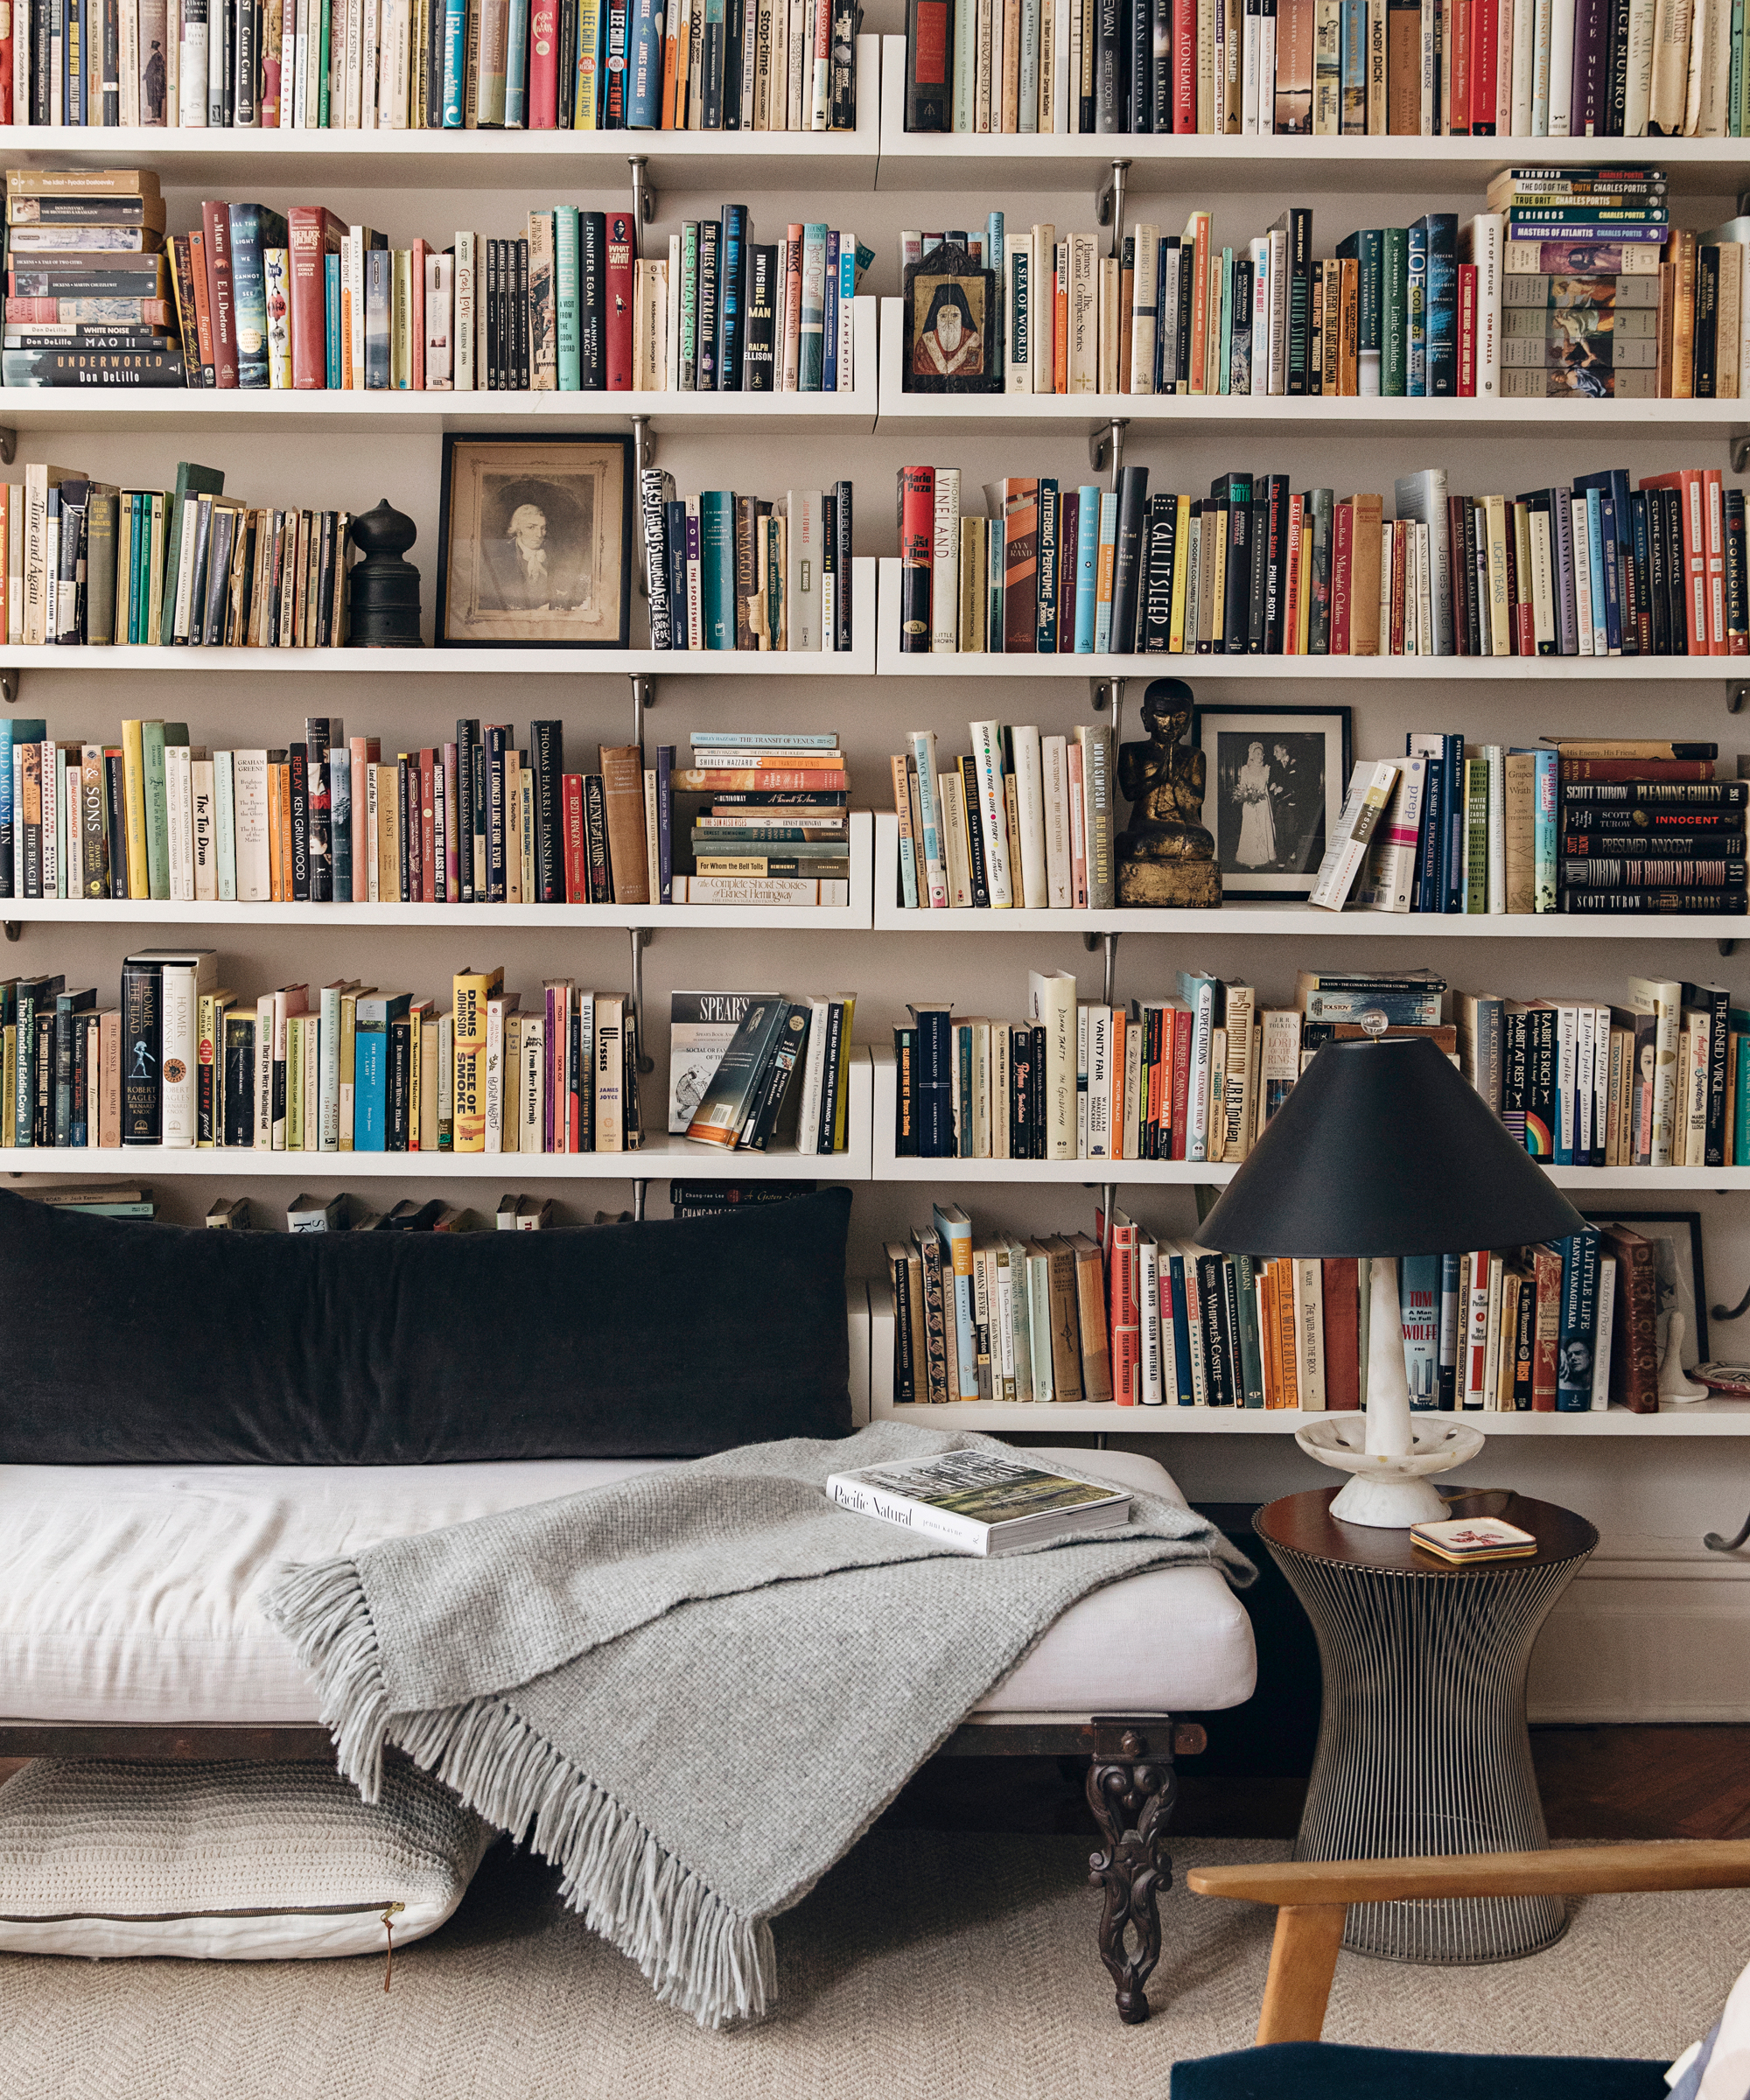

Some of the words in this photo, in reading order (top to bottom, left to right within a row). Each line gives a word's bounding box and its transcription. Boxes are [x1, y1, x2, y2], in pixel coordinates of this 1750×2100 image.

[583, 10, 595, 25] LEE
[611, 10, 625, 25] LEE
[242, 27, 250, 56] CALEB
[582, 29, 594, 53] CHILD
[610, 28, 623, 53] CHILD
[760, 10, 771, 75] Stop-time
[1373, 21, 1382, 52] MOBY
[1180, 32, 1190, 109] ATONEMENT
[611, 87, 622, 117] ENEMY
[214, 224, 223, 252] MARCH
[686, 227, 695, 268] LESS
[1074, 239, 1083, 280] O'Connor
[1082, 243, 1093, 279] Flannery
[1408, 241, 1425, 287] JOE
[1488, 250, 1494, 260] OF
[218, 281, 228, 290] E.
[685, 271, 694, 312] THAN
[756, 255, 766, 304] INVISIBLE
[1018, 267, 1026, 290] SEA
[749, 307, 771, 318] MAN
[1018, 293, 1026, 310] OF
[1075, 284, 1085, 323] Complete
[201, 316, 210, 351] Ragtime
[219, 303, 228, 344] Doctorow
[1390, 306, 1399, 331] Little
[683, 317, 693, 360] ZERO
[1018, 313, 1026, 361] WORDS
[1076, 325, 1085, 352] Stories
[1390, 333, 1399, 372] Children
[58, 356, 162, 368] UNDERWORLD
[744, 352, 772, 361] ELLISON
[80, 372, 97, 382] Don
[103, 372, 139, 382] DeLillo
[1271, 483, 1280, 499] The
[31, 501, 44, 533] Time
[934, 478, 949, 558] VINELAND
[1043, 488, 1055, 546] JITTERBUG
[31, 536, 43, 560] and
[1152, 522, 1172, 556] CALL
[1151, 562, 1171, 578] IT
[1494, 542, 1503, 570] LIGHT
[28, 564, 43, 605] Again
[1042, 550, 1054, 598] PERFUME
[1494, 573, 1504, 603] YEARS
[1148, 579, 1169, 624] SLEEP
[87, 768, 99, 779] &
[88, 788, 100, 831] SONS
[197, 794, 208, 813] The
[542, 775, 551, 816] HARRIS
[1407, 785, 1418, 819] prep
[198, 816, 209, 833] Tin
[199, 837, 209, 865] Drum
[543, 824, 552, 883] HANNIBAL
[130, 982, 139, 1001] THE
[144, 986, 152, 1027] HOMER
[130, 1004, 139, 1033] ILIAD
[458, 990, 466, 1036] JOHNSON
[467, 990, 476, 1036] DENIS
[1716, 1000, 1726, 1019] THE
[1096, 1019, 1104, 1057] VANITY
[1226, 1003, 1250, 1074] SILMARILLION
[1541, 1013, 1551, 1048] RABBIT
[1714, 1021, 1725, 1058] AENEID
[599, 1027, 619, 1071] ULYSSES
[1096, 1060, 1104, 1081] FAIR
[1541, 1061, 1550, 1086] RICH
[1712, 1062, 1724, 1094] VIRGIL
[467, 1095, 475, 1114] OF
[1572, 1237, 1580, 1267] HANYA
[1583, 1250, 1594, 1295] LITTLE
[1568, 1270, 1579, 1328] YANAGIHARA
[1581, 1301, 1591, 1329] LIFE
[1212, 1345, 1222, 1381] CASTLE
[1516, 1362, 1530, 1381] RUSH
[834, 1485, 868, 1512] Pacific
[873, 1497, 912, 1526] Natural
[922, 1520, 941, 1530] jenni
